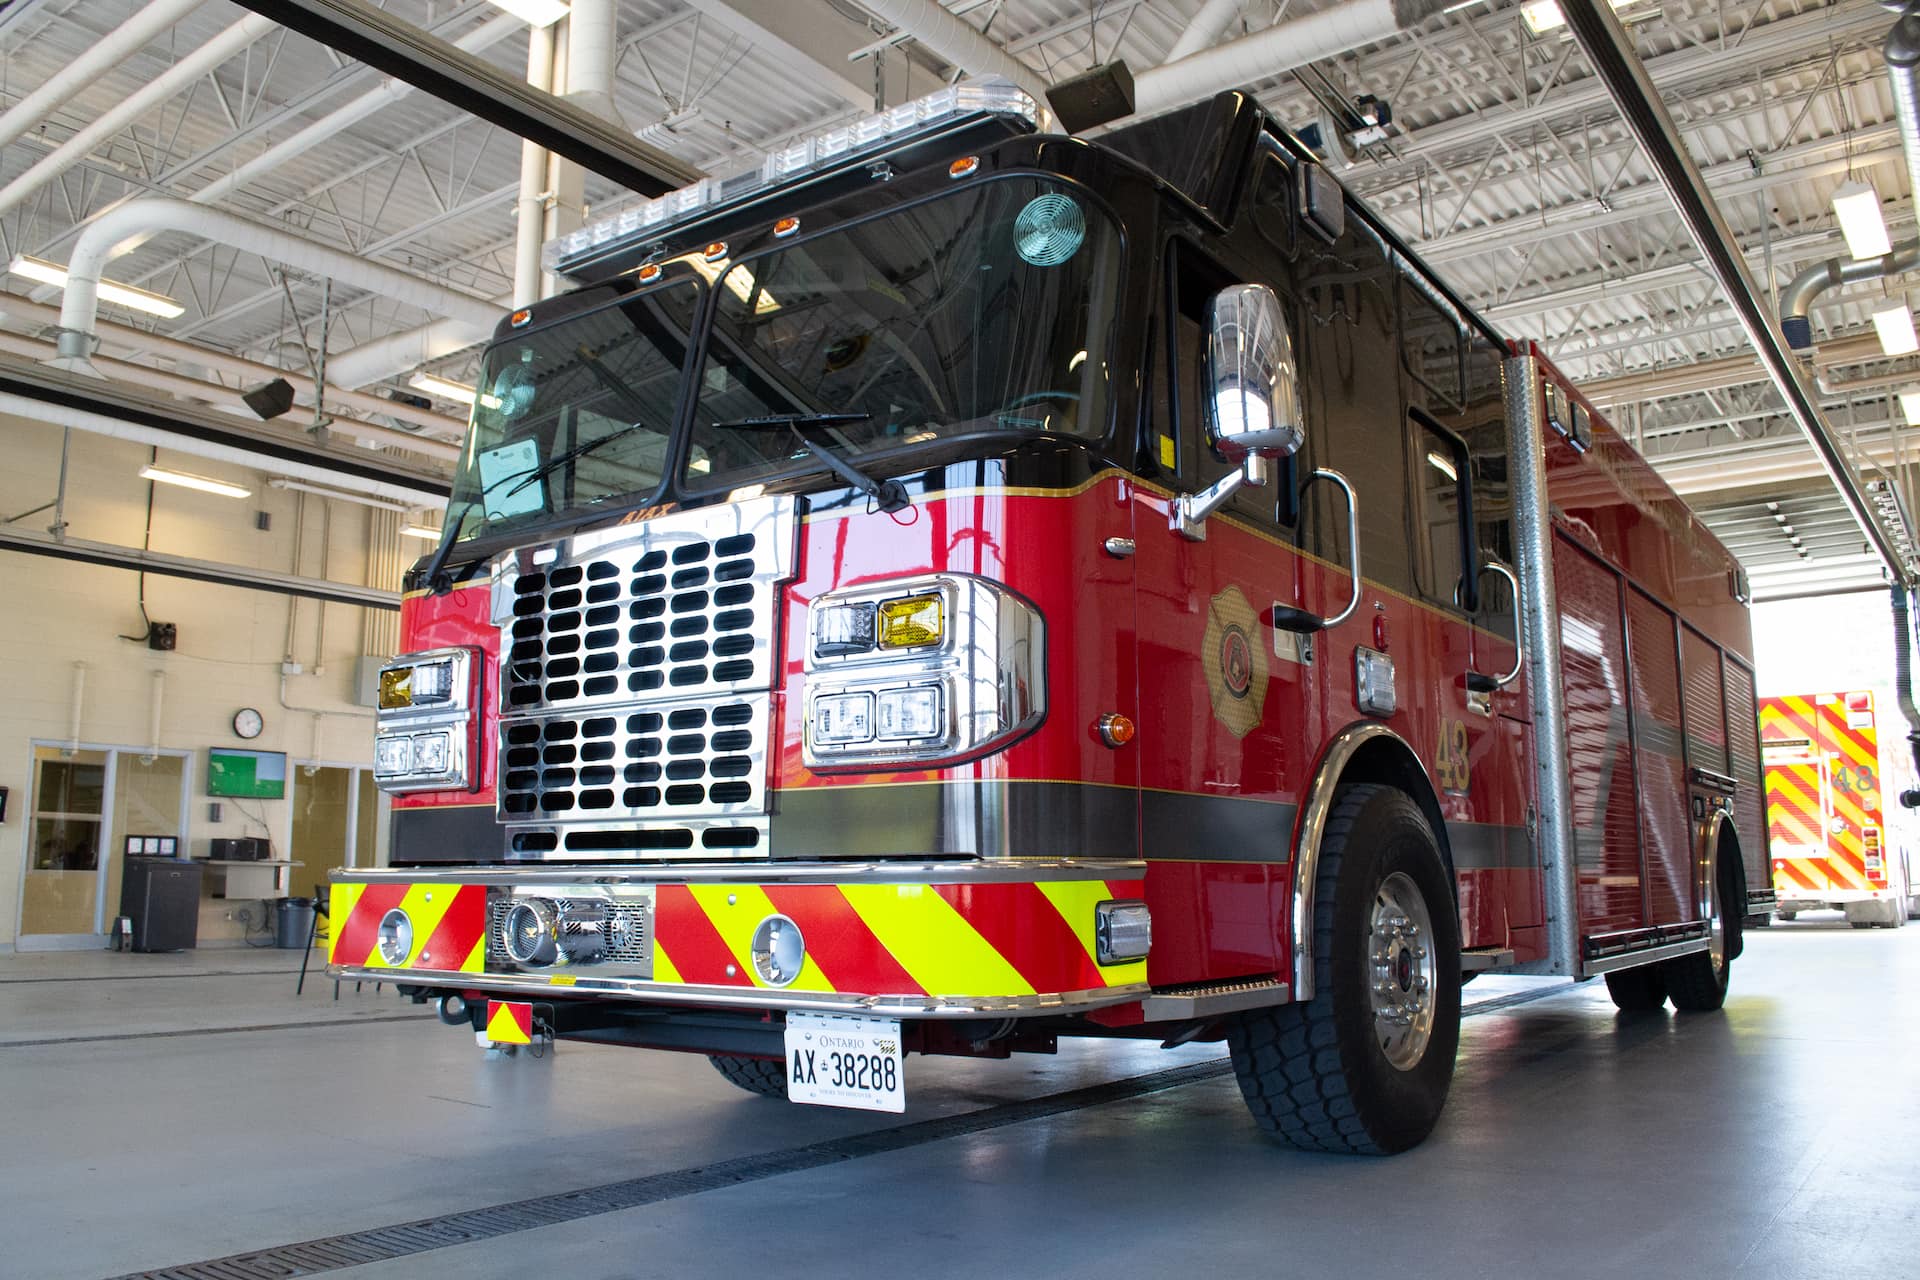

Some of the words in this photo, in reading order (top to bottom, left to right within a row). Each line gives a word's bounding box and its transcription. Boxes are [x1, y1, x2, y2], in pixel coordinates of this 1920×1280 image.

[1833, 765, 1874, 792] 48
[819, 1035, 864, 1049] ONTARIO
[792, 1049, 817, 1084] AX
[830, 1051, 896, 1092] 38288
